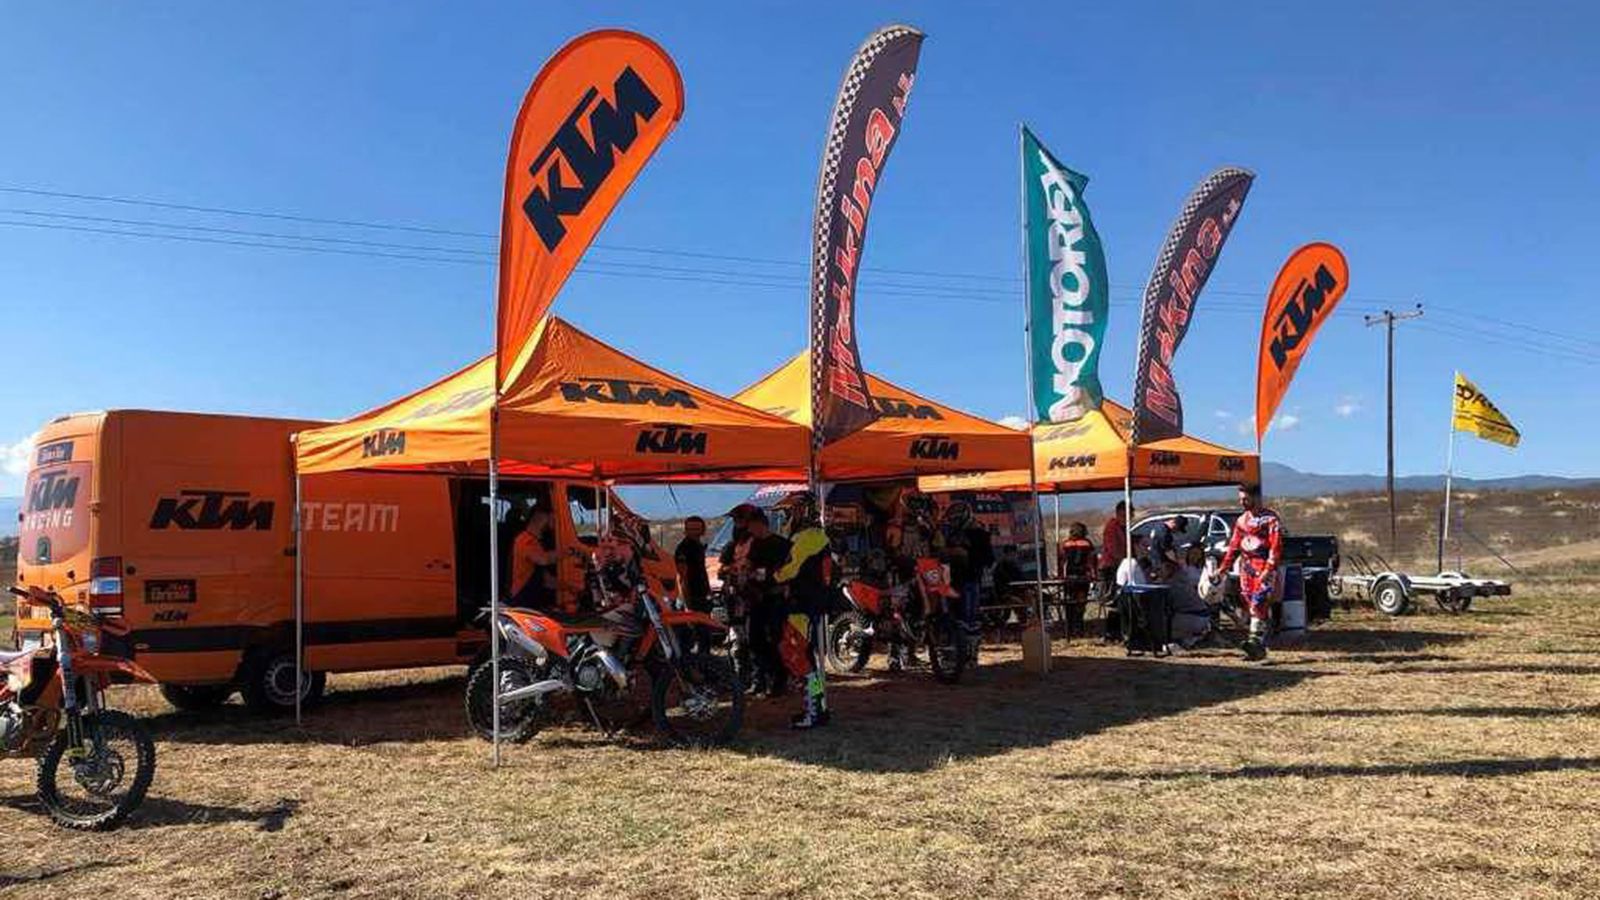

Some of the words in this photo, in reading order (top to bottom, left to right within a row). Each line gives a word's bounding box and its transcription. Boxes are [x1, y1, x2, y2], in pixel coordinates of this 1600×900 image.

[523, 66, 662, 253] KTM
[1039, 149, 1096, 423] MOTOREX
[1269, 264, 1338, 371] KTM
[560, 377, 699, 409] KTM
[363, 427, 406, 458] KTM
[635, 422, 706, 455] KTM
[909, 433, 959, 460] KTM
[28, 469, 80, 511] KTM
[150, 490, 275, 530] KTM
[302, 502, 400, 532] TEAM
